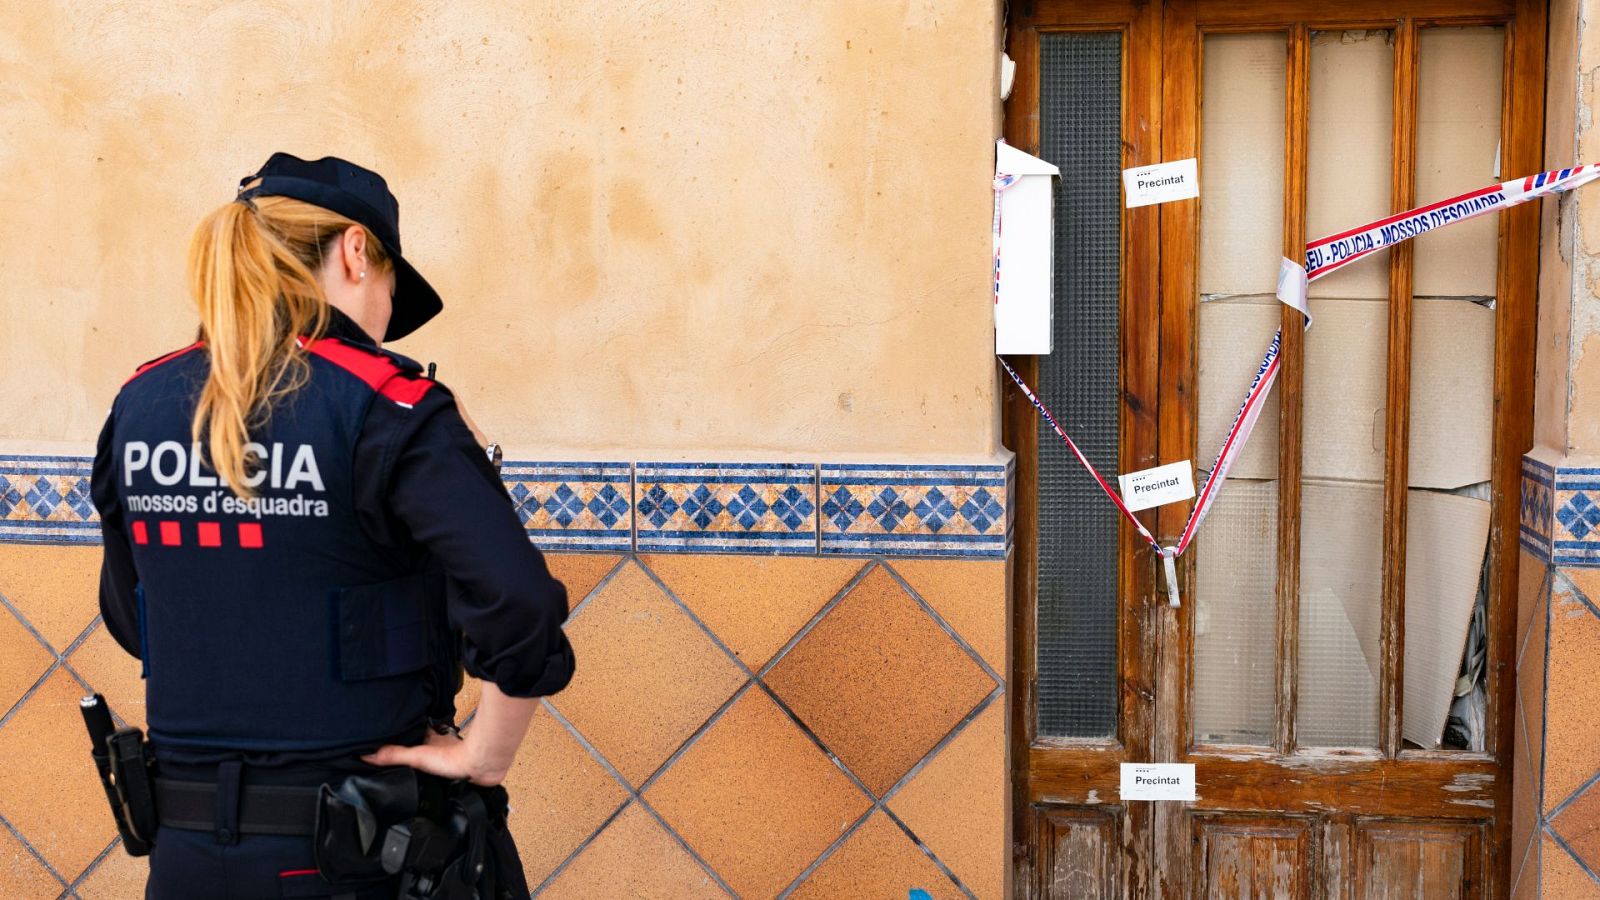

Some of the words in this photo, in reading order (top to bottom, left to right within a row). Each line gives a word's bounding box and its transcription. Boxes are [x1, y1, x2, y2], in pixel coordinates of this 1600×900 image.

[1137, 174, 1185, 189] Precintat
[1330, 233, 1374, 262] POLICIA
[1380, 215, 1430, 246] MOSSOS
[124, 440, 326, 491] POLCIA
[1134, 476, 1180, 494] Precintat
[127, 494, 198, 513] mossos
[1135, 776, 1181, 785] Precintat
